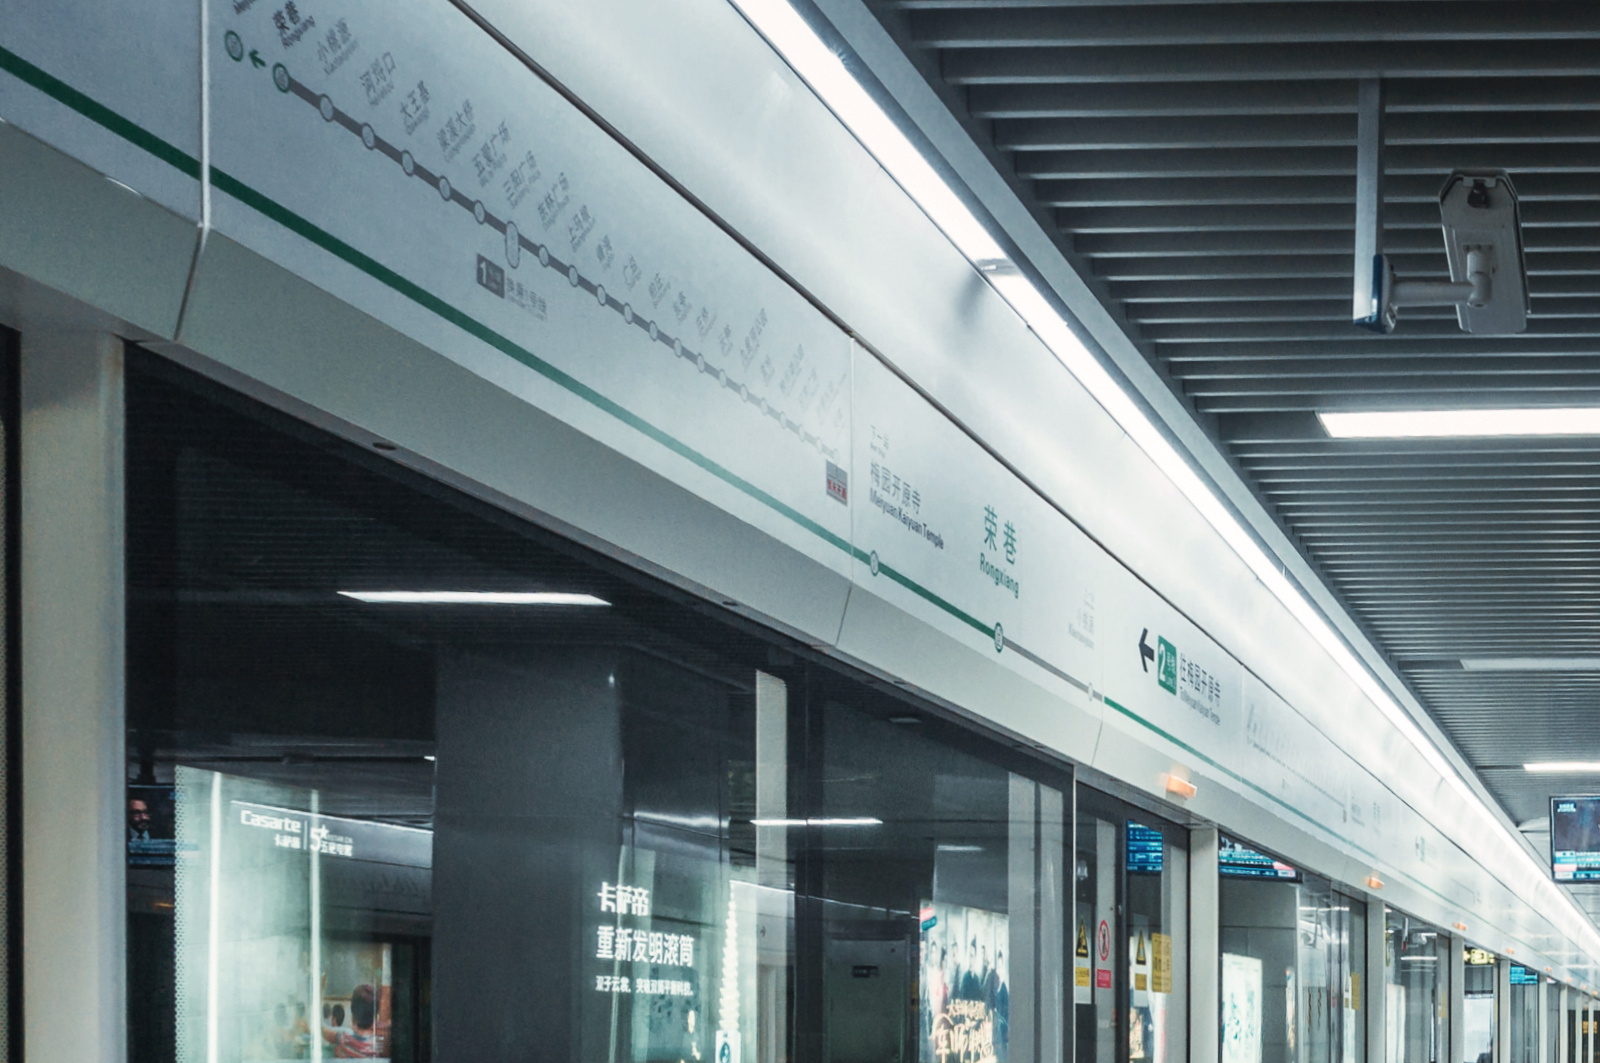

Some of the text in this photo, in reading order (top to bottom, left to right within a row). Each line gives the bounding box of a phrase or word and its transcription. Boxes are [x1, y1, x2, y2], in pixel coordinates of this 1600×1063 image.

[870, 459, 921, 515] 梅园开原寺
[870, 487, 945, 550] Meiyuan Kaiyuan Temple
[984, 504, 1018, 566] 荣巷
[980, 552, 1020, 599] Rongxiang
[240, 810, 301, 833] Casarte
[597, 881, 650, 916] 卡萨帝
[596, 925, 695, 967] 重新发明滚筒
